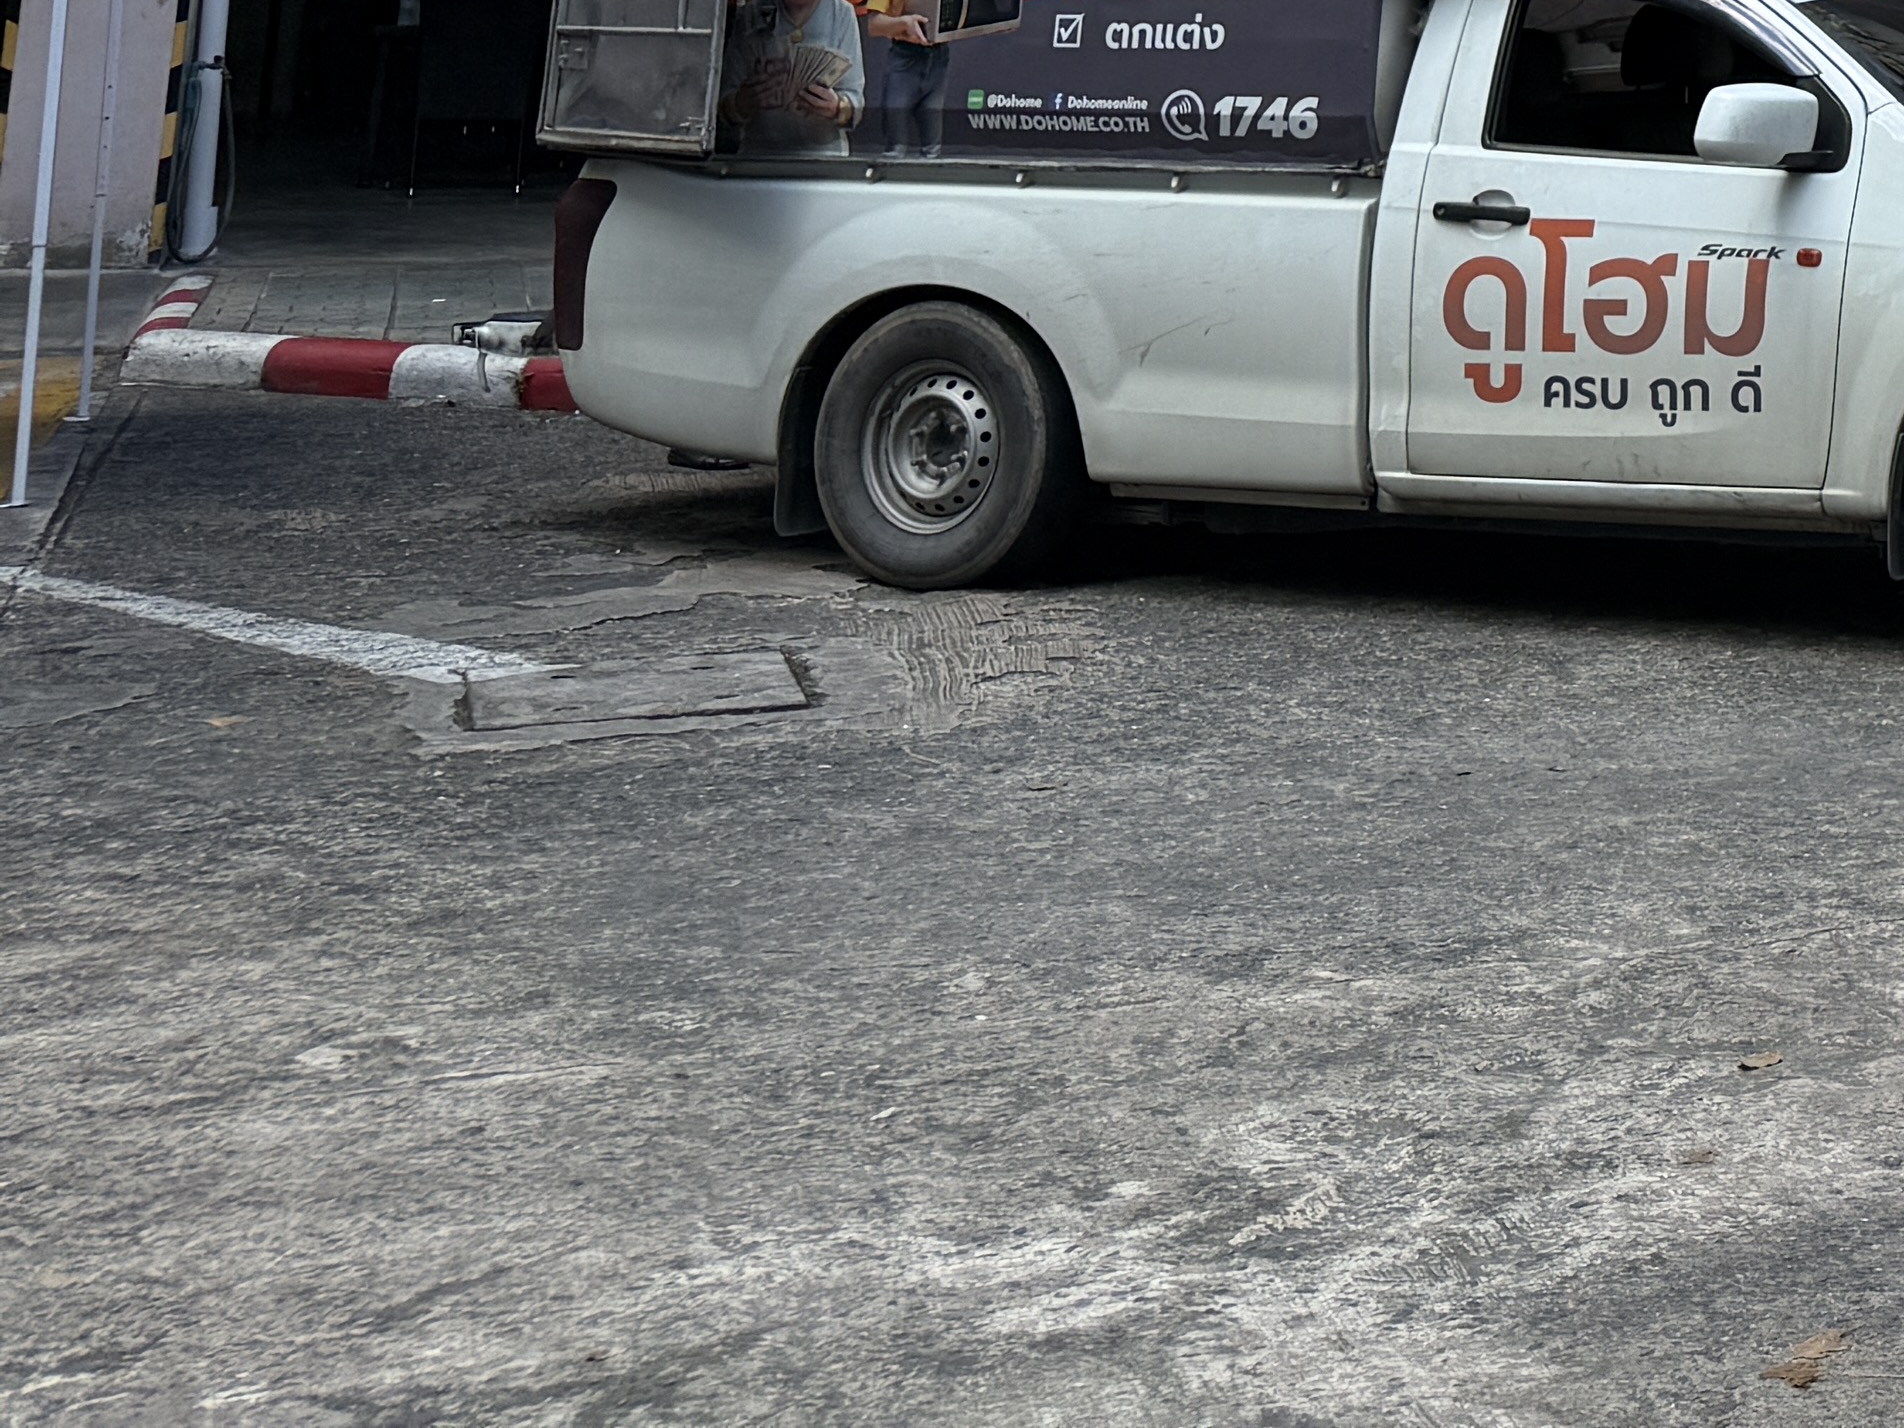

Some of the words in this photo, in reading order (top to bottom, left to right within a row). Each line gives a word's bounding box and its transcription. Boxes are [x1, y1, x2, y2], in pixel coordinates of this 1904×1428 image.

[1104, 14, 1226, 54] ตกแต่ง
[967, 112, 1150, 134] WWW.DOHOME.CO.TH
[1212, 95, 1319, 140] 1746
[1697, 242, 1786, 262] Spark
[1442, 217, 1771, 403] ดูโฮม
[1543, 373, 1630, 411] ครบ
[1650, 376, 1710, 428] ถูก
[1730, 364, 1763, 414] ดี
